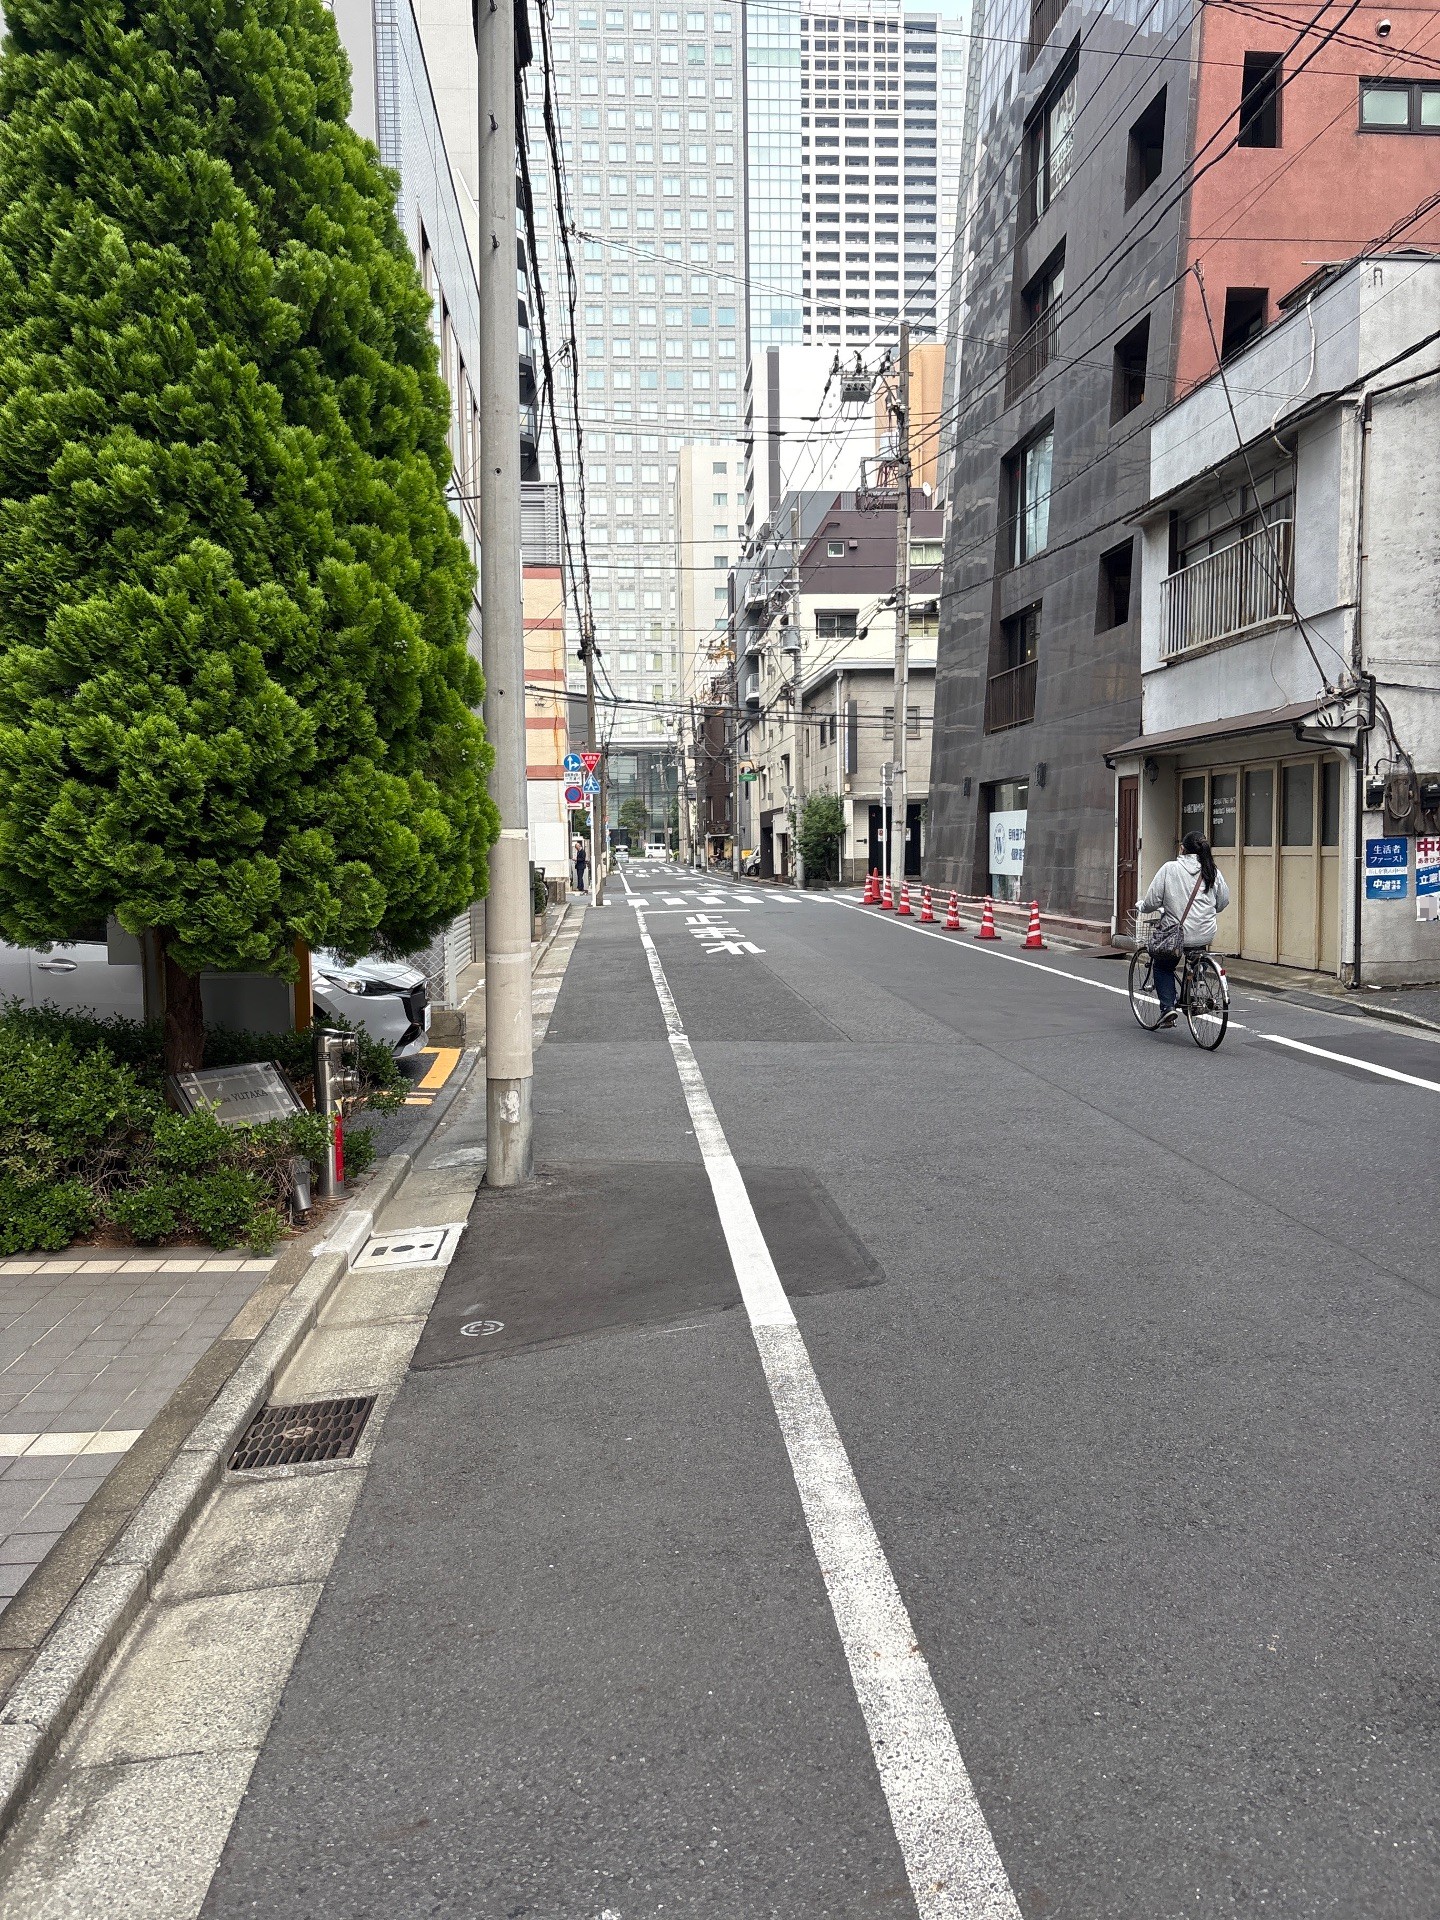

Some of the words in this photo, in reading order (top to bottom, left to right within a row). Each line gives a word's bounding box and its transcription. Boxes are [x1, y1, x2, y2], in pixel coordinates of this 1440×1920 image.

[1373, 845, 1401, 854] 生活者
[1370, 855, 1403, 864] ファースト
[684, 913, 767, 955] 止まれ
[230, 1089, 269, 1101] YUTAKA
